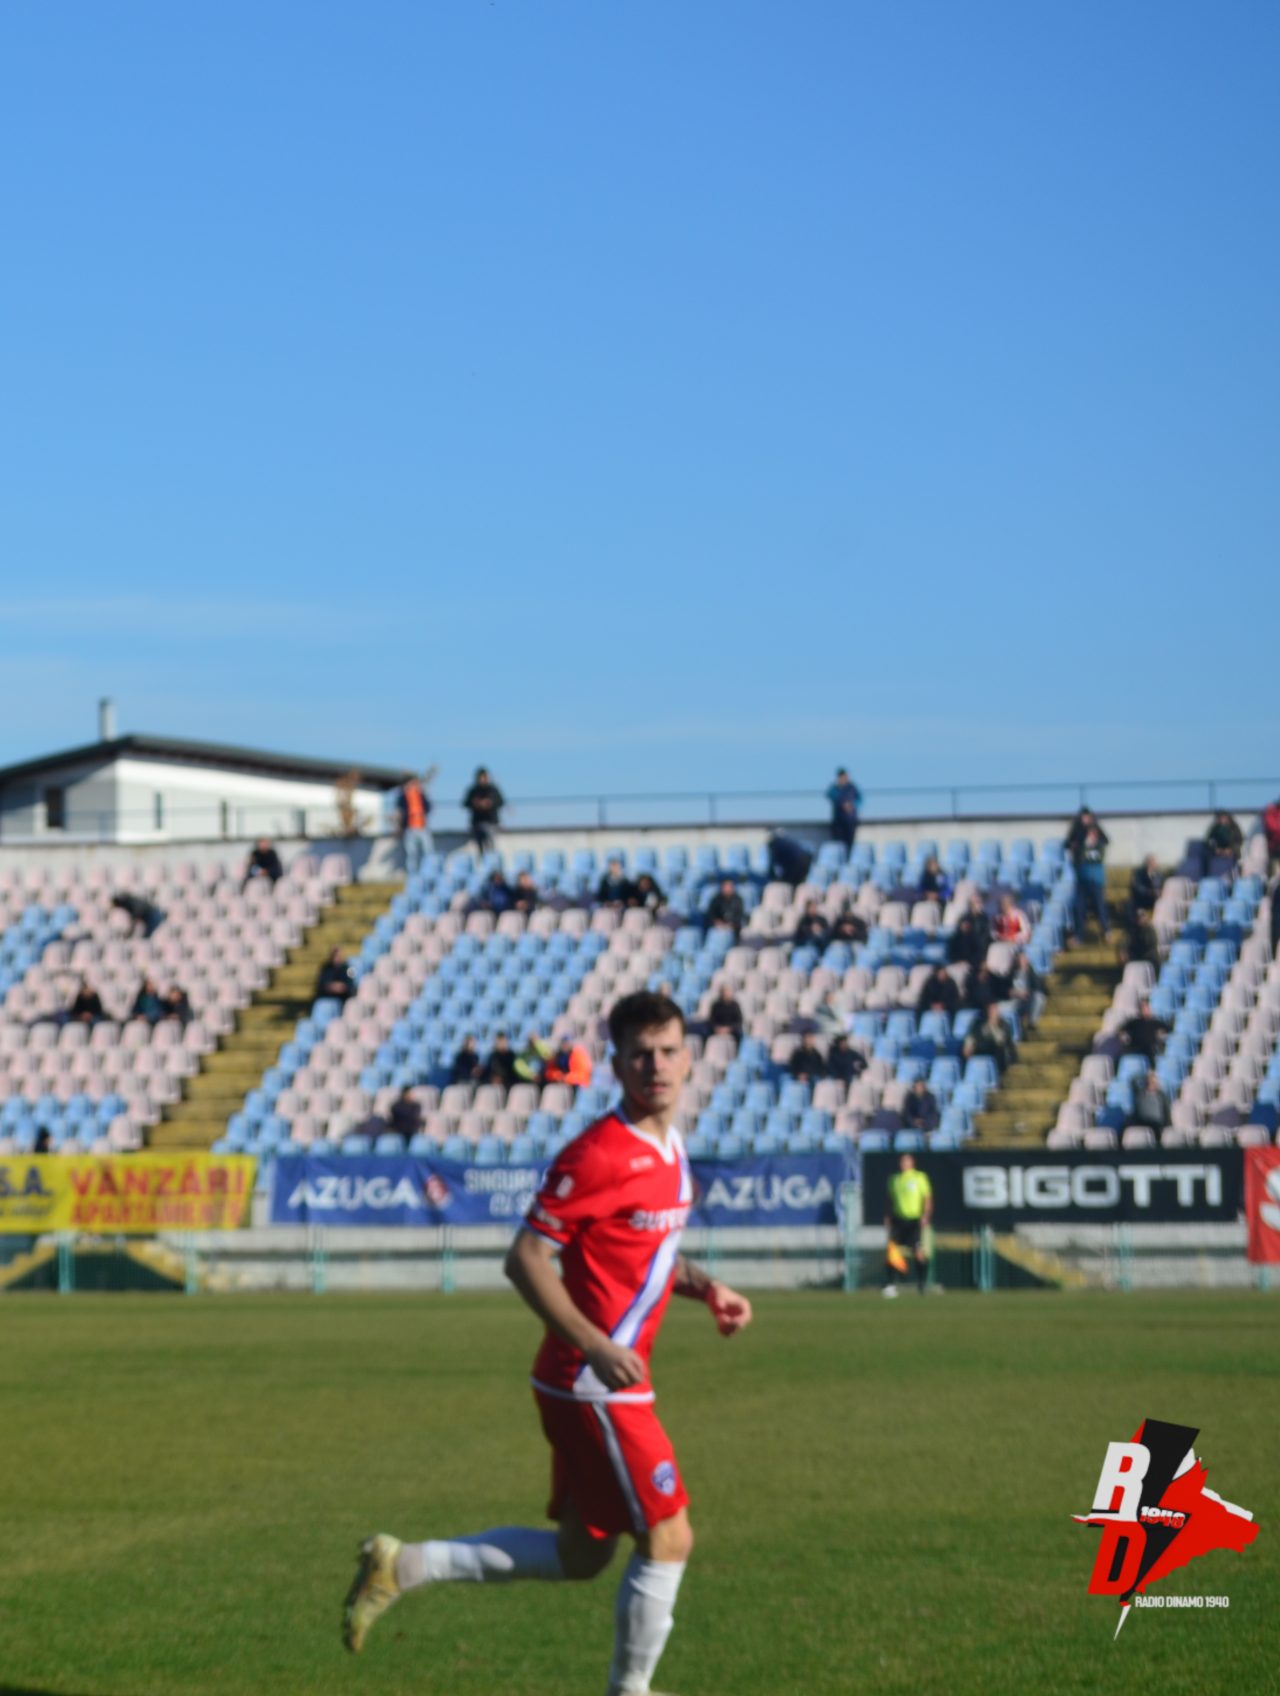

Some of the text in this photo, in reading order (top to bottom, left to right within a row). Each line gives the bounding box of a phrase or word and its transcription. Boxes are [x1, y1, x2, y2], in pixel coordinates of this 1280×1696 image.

[287, 1177, 419, 1210] AZUGA
[706, 1175, 832, 1210] AZUGA
[963, 1165, 1221, 1208] BIGOTTI
